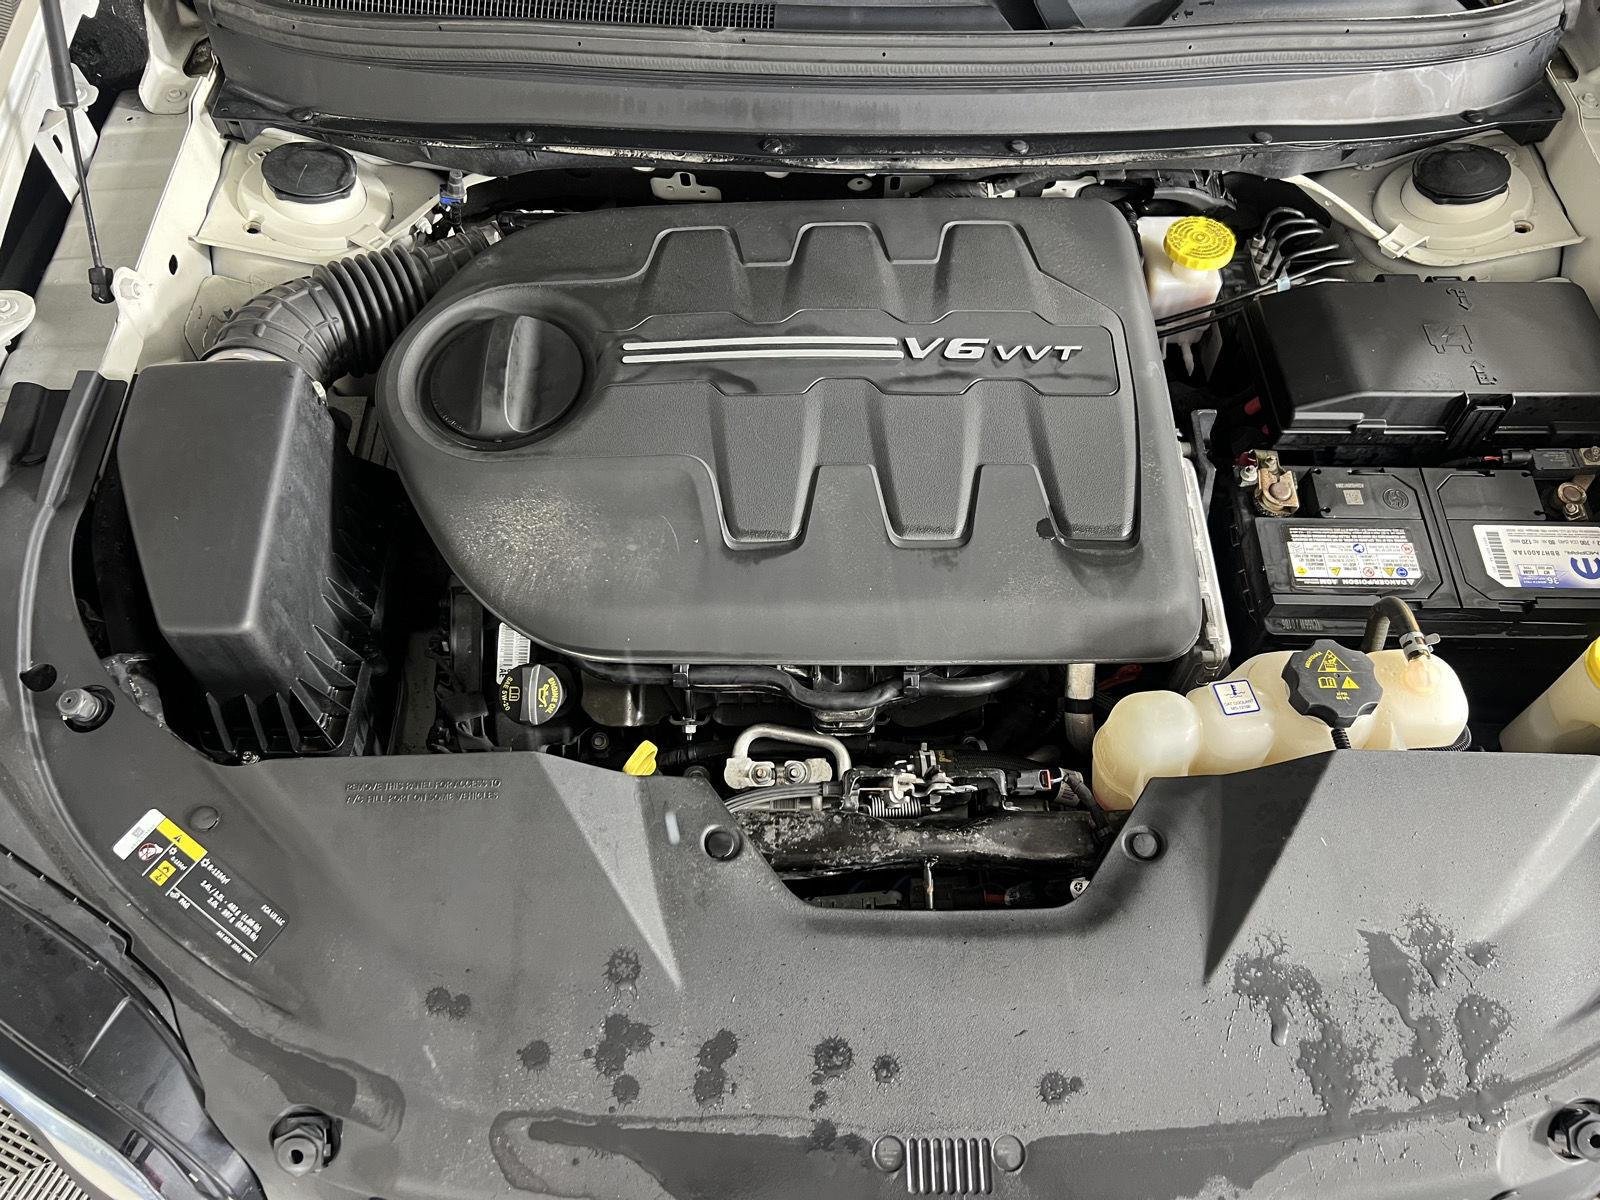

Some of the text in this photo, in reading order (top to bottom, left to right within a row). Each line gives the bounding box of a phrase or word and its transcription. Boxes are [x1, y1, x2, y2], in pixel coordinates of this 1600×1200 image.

[905, 337, 1083, 361] V6 VVT
[502, 676, 513, 711] SAE 5W-20
[545, 677, 559, 714] ENGINE OIL
[346, 778, 501, 792] REMOVE THIS PANEL FOR ACCESS TO
[367, 794, 386, 803] FILL
[388, 794, 410, 803] PORT
[413, 793, 427, 802] ON
[429, 793, 453, 802] SOME
[458, 792, 500, 801] VEHICLES
[260, 904, 272, 916] FCA
[275, 917, 286, 926] LLC
